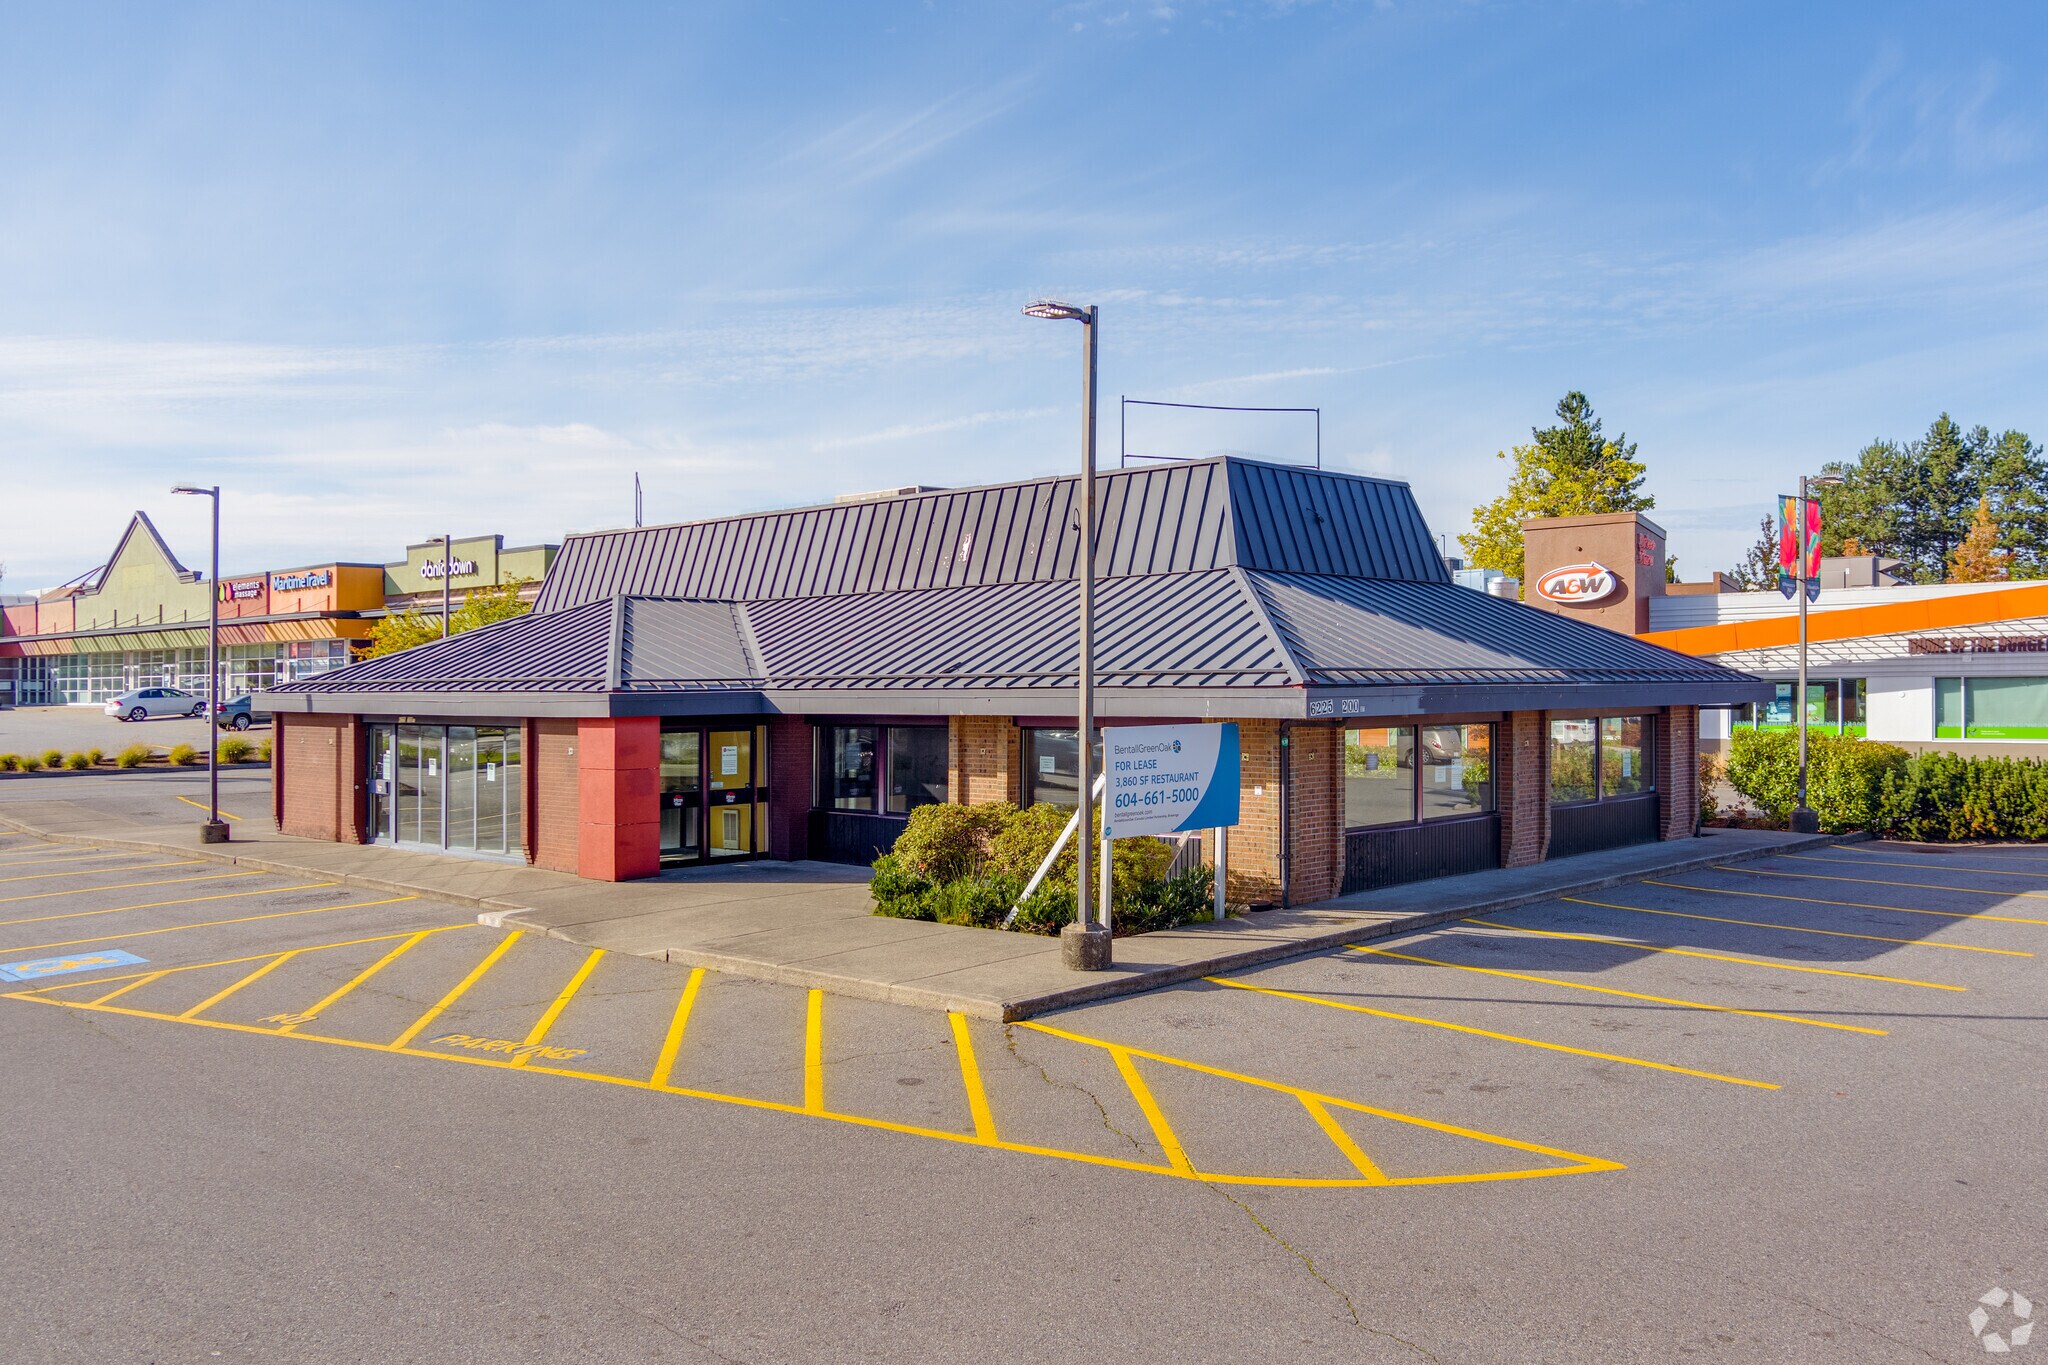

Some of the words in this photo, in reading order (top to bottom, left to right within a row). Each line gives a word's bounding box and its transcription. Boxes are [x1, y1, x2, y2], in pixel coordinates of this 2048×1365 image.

[233, 581, 260, 591] elements
[273, 575, 305, 591] Maritime
[305, 570, 329, 587] Travel
[1548, 577, 1606, 595] A&W
[234, 589, 258, 598] massage
[1908, 638, 1948, 654] HOME
[1950, 637, 1964, 653] OF
[1969, 636, 1996, 653] THE
[1998, 635, 2048, 653] BURGE
[1310, 700, 1333, 716] 6225
[1342, 699, 1359, 713] 200
[1114, 742, 1172, 755] BentallGreenOak
[1115, 761, 1131, 771] FOR
[1133, 759, 1157, 770] LEASE
[1116, 776, 1137, 788] 3,860
[1140, 775, 1149, 785] SF
[1151, 772, 1199, 784] RESTAURANT
[1115, 787, 1199, 808] 604-661-5000
[430, 1033, 588, 1061] PARKING
